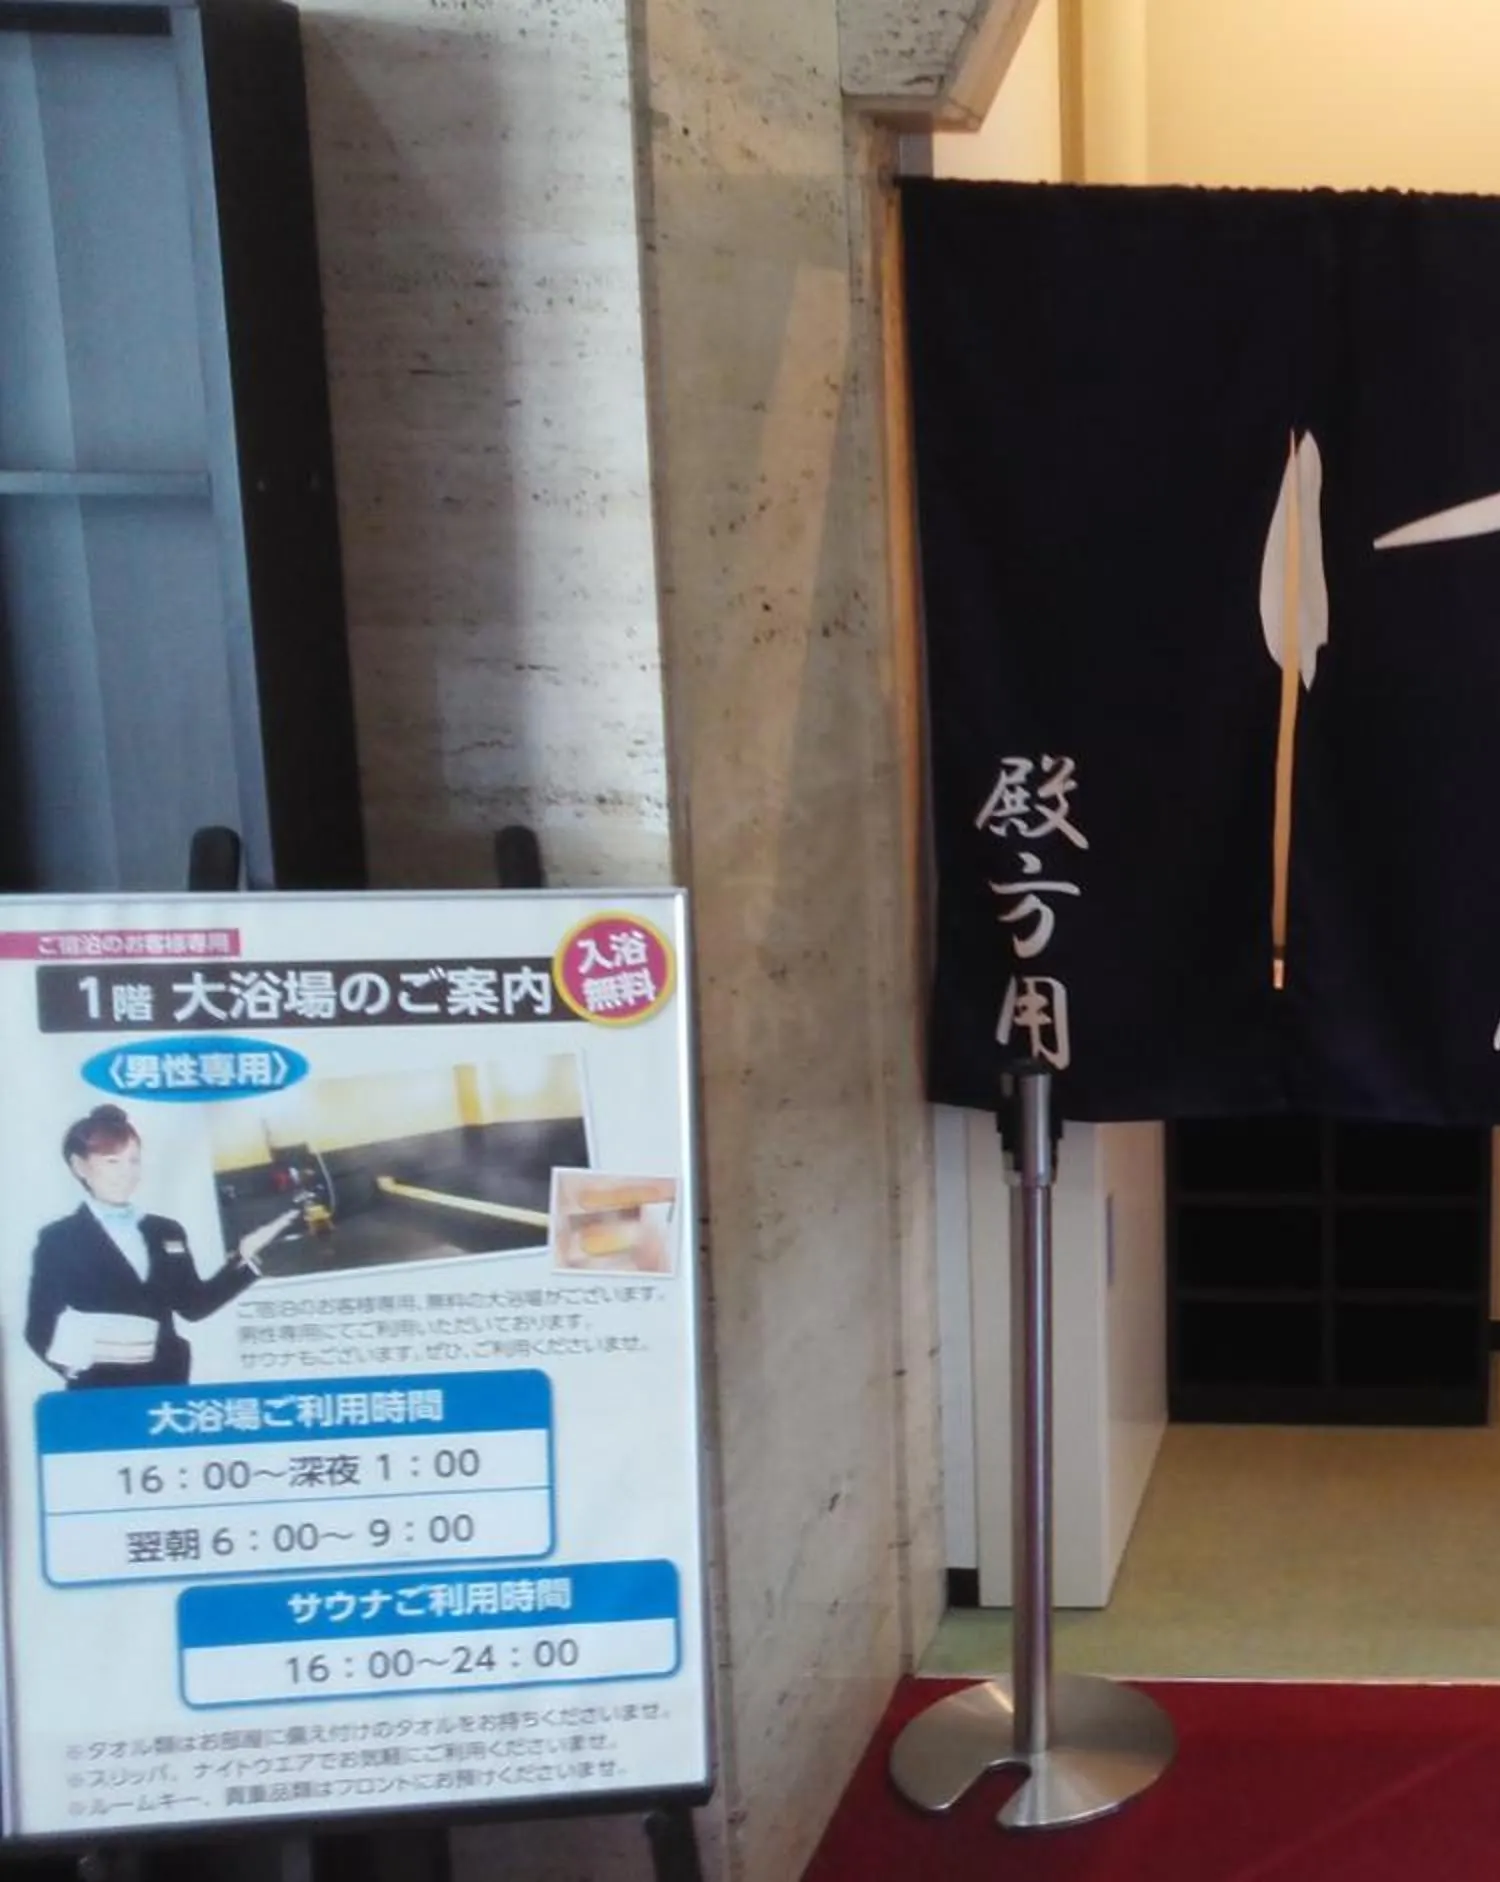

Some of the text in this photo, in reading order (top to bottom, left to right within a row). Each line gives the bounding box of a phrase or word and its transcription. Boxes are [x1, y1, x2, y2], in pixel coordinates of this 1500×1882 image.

[975, 754, 1090, 1070] 殿方用
[576, 929, 648, 974] 入浴
[171, 968, 552, 1022] 大浴場のご案内
[582, 966, 657, 1012] 無料
[147, 1389, 445, 1435] 大浴場ご利用時間
[287, 1578, 572, 1624] サウナご利用時間
